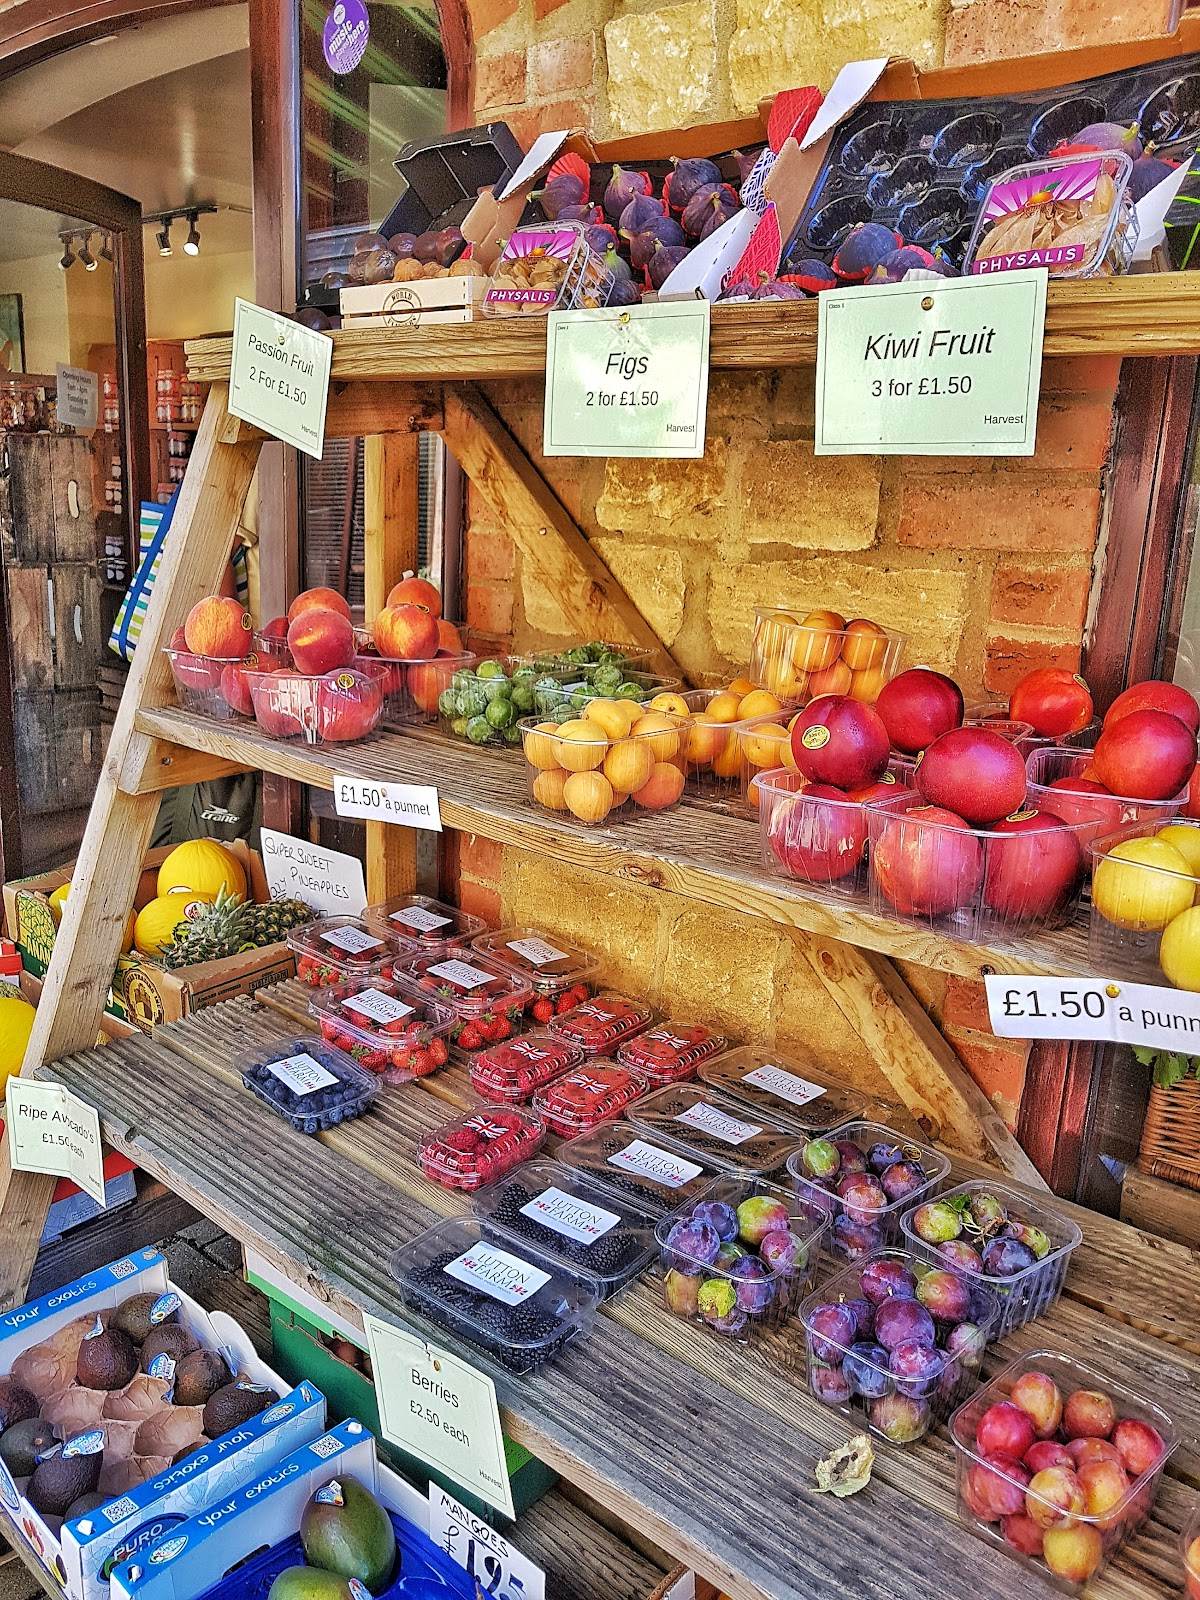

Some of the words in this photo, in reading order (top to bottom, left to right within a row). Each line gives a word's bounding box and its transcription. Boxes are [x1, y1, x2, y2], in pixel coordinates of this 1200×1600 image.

[328, 20, 353, 55] music
[347, 20, 366, 47] here
[979, 248, 1077, 274] PHYSALIS
[490, 290, 551, 301] PHYSALIS
[248, 333, 289, 364] Passion
[290, 354, 314, 377] Fruit
[864, 330, 922, 361] Kiwi
[928, 325, 996, 357] Fruit
[605, 351, 649, 380] Figs
[249, 366, 256, 381] 2
[258, 370, 276, 390] For
[278, 380, 307, 406] £1.50
[586, 391, 594, 406] 2
[598, 391, 617, 406] for
[620, 390, 659, 406] £1.50
[871, 379, 882, 397] 3
[888, 378, 913, 397] for
[918, 375, 972, 396] £1.50
[666, 423, 695, 433] Harvest
[983, 413, 1024, 425] Harvest
[341, 784, 381, 808] £1.50
[385, 798, 392, 810] a
[394, 800, 431, 816] punnet
[290, 866, 349, 899] PINEAPPLES
[1002, 989, 1105, 1018] £1.50
[1118, 1005, 1134, 1023] a
[18, 1104, 48, 1120] Ripe
[634, 1158, 670, 1176] FARM
[635, 1149, 685, 1175] LUTTON
[548, 1206, 585, 1228] FARM
[550, 1197, 602, 1225] LUTTON
[474, 1264, 513, 1288] FARM
[478, 1253, 530, 1284] LUTTON
[4, 1305, 40, 1328] your
[47, 1280, 98, 1308] exotics
[411, 1368, 460, 1409] Berries
[410, 1400, 440, 1428] £2.50
[443, 1422, 470, 1448] each
[217, 1430, 254, 1455] your
[152, 1454, 210, 1490] exotics
[197, 1499, 238, 1527] your
[244, 1462, 300, 1499] exotics
[440, 1494, 509, 1558] MANGOES
[113, 1523, 163, 1561] PURO
